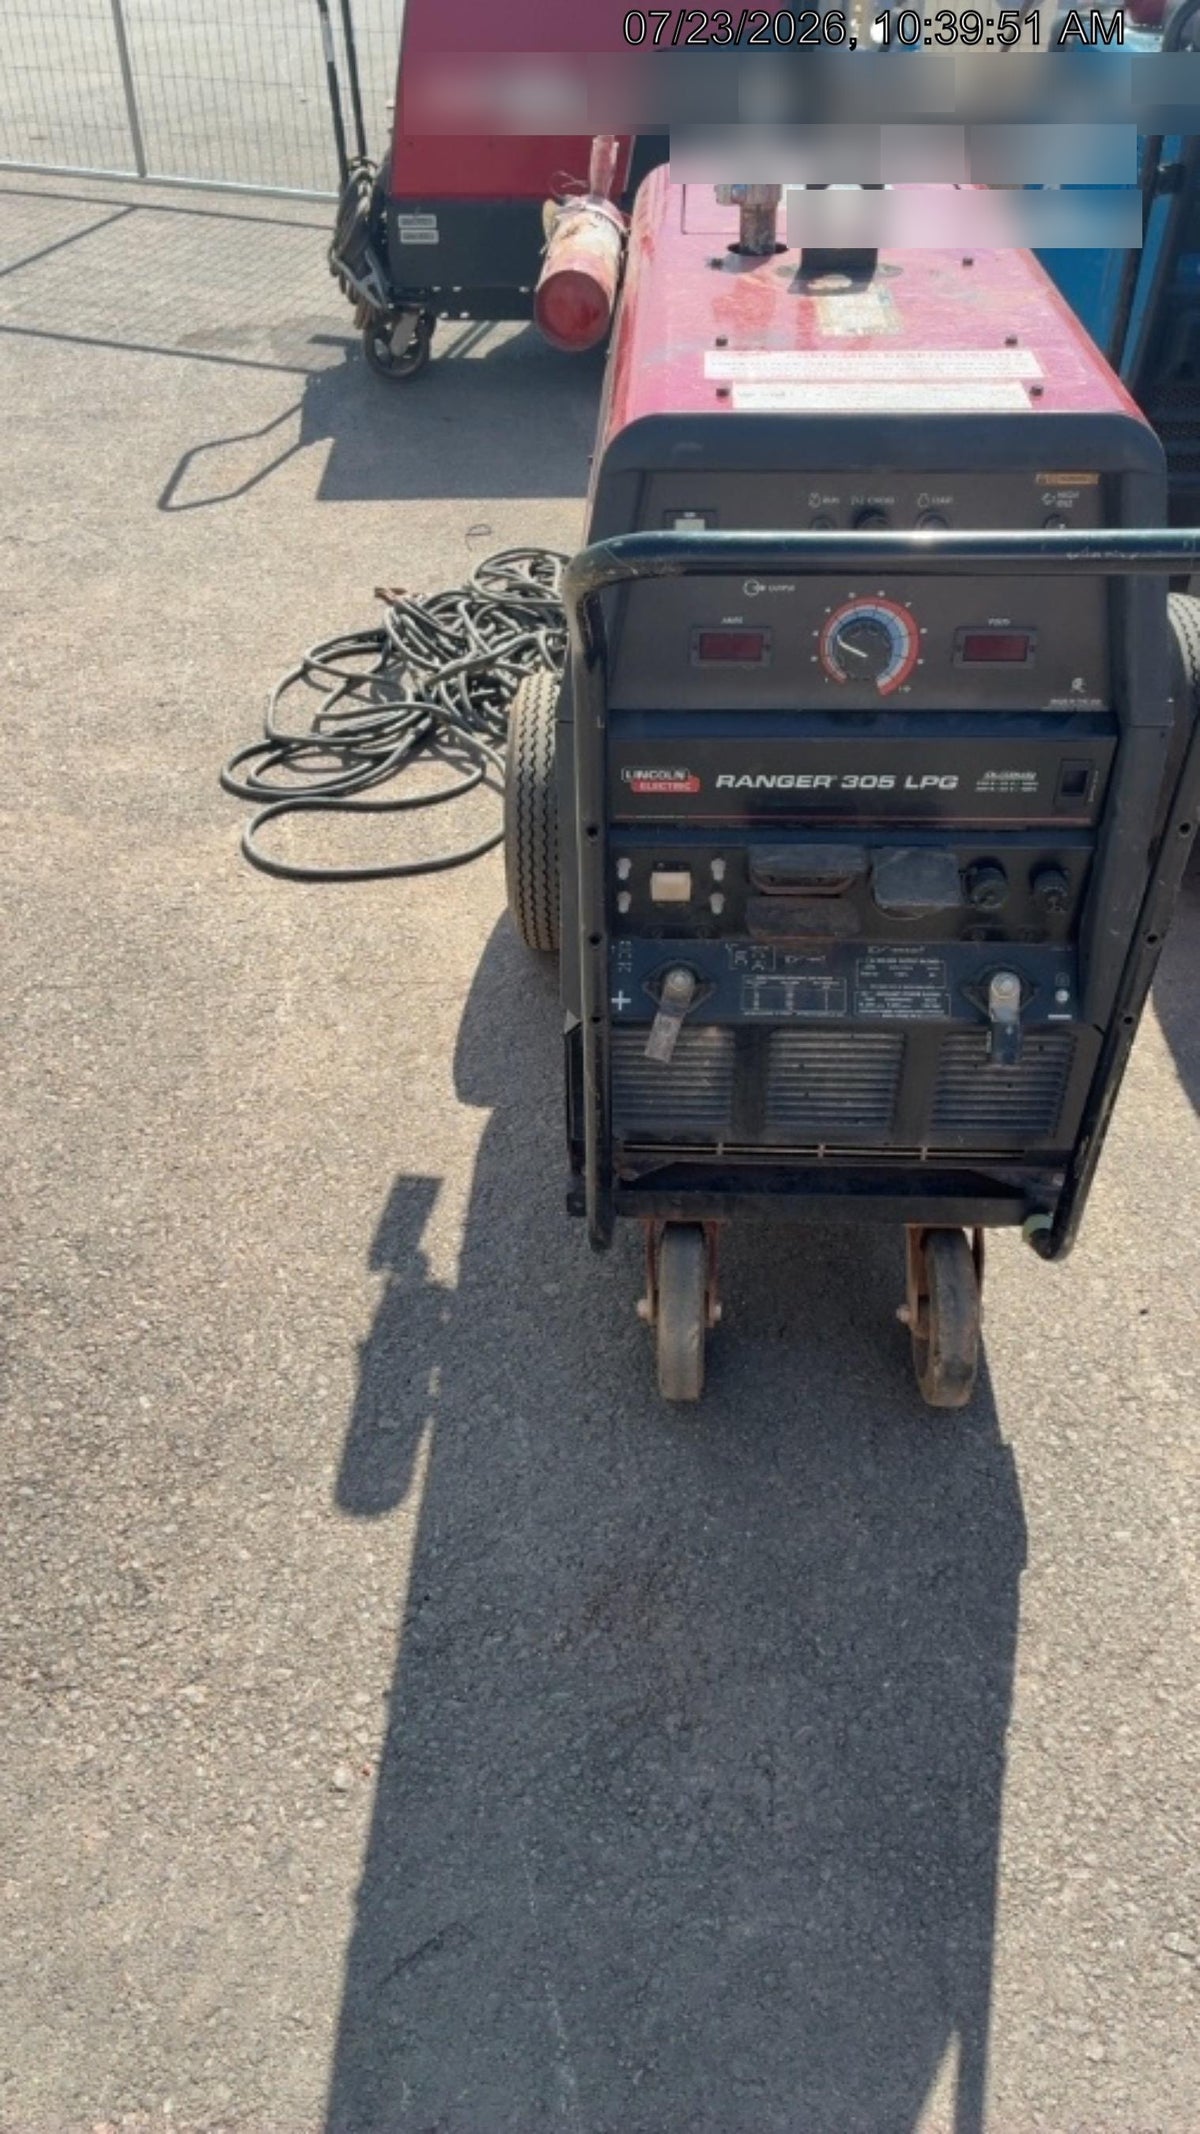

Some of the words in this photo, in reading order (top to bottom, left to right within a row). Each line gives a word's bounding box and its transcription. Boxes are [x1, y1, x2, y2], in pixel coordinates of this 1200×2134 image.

[624, 769, 686, 781] LINCOLN
[638, 781, 692, 791] ELECTRIC
[715, 774, 833, 789] RANGER
[840, 774, 897, 789] 305
[904, 774, 960, 790] LPG
